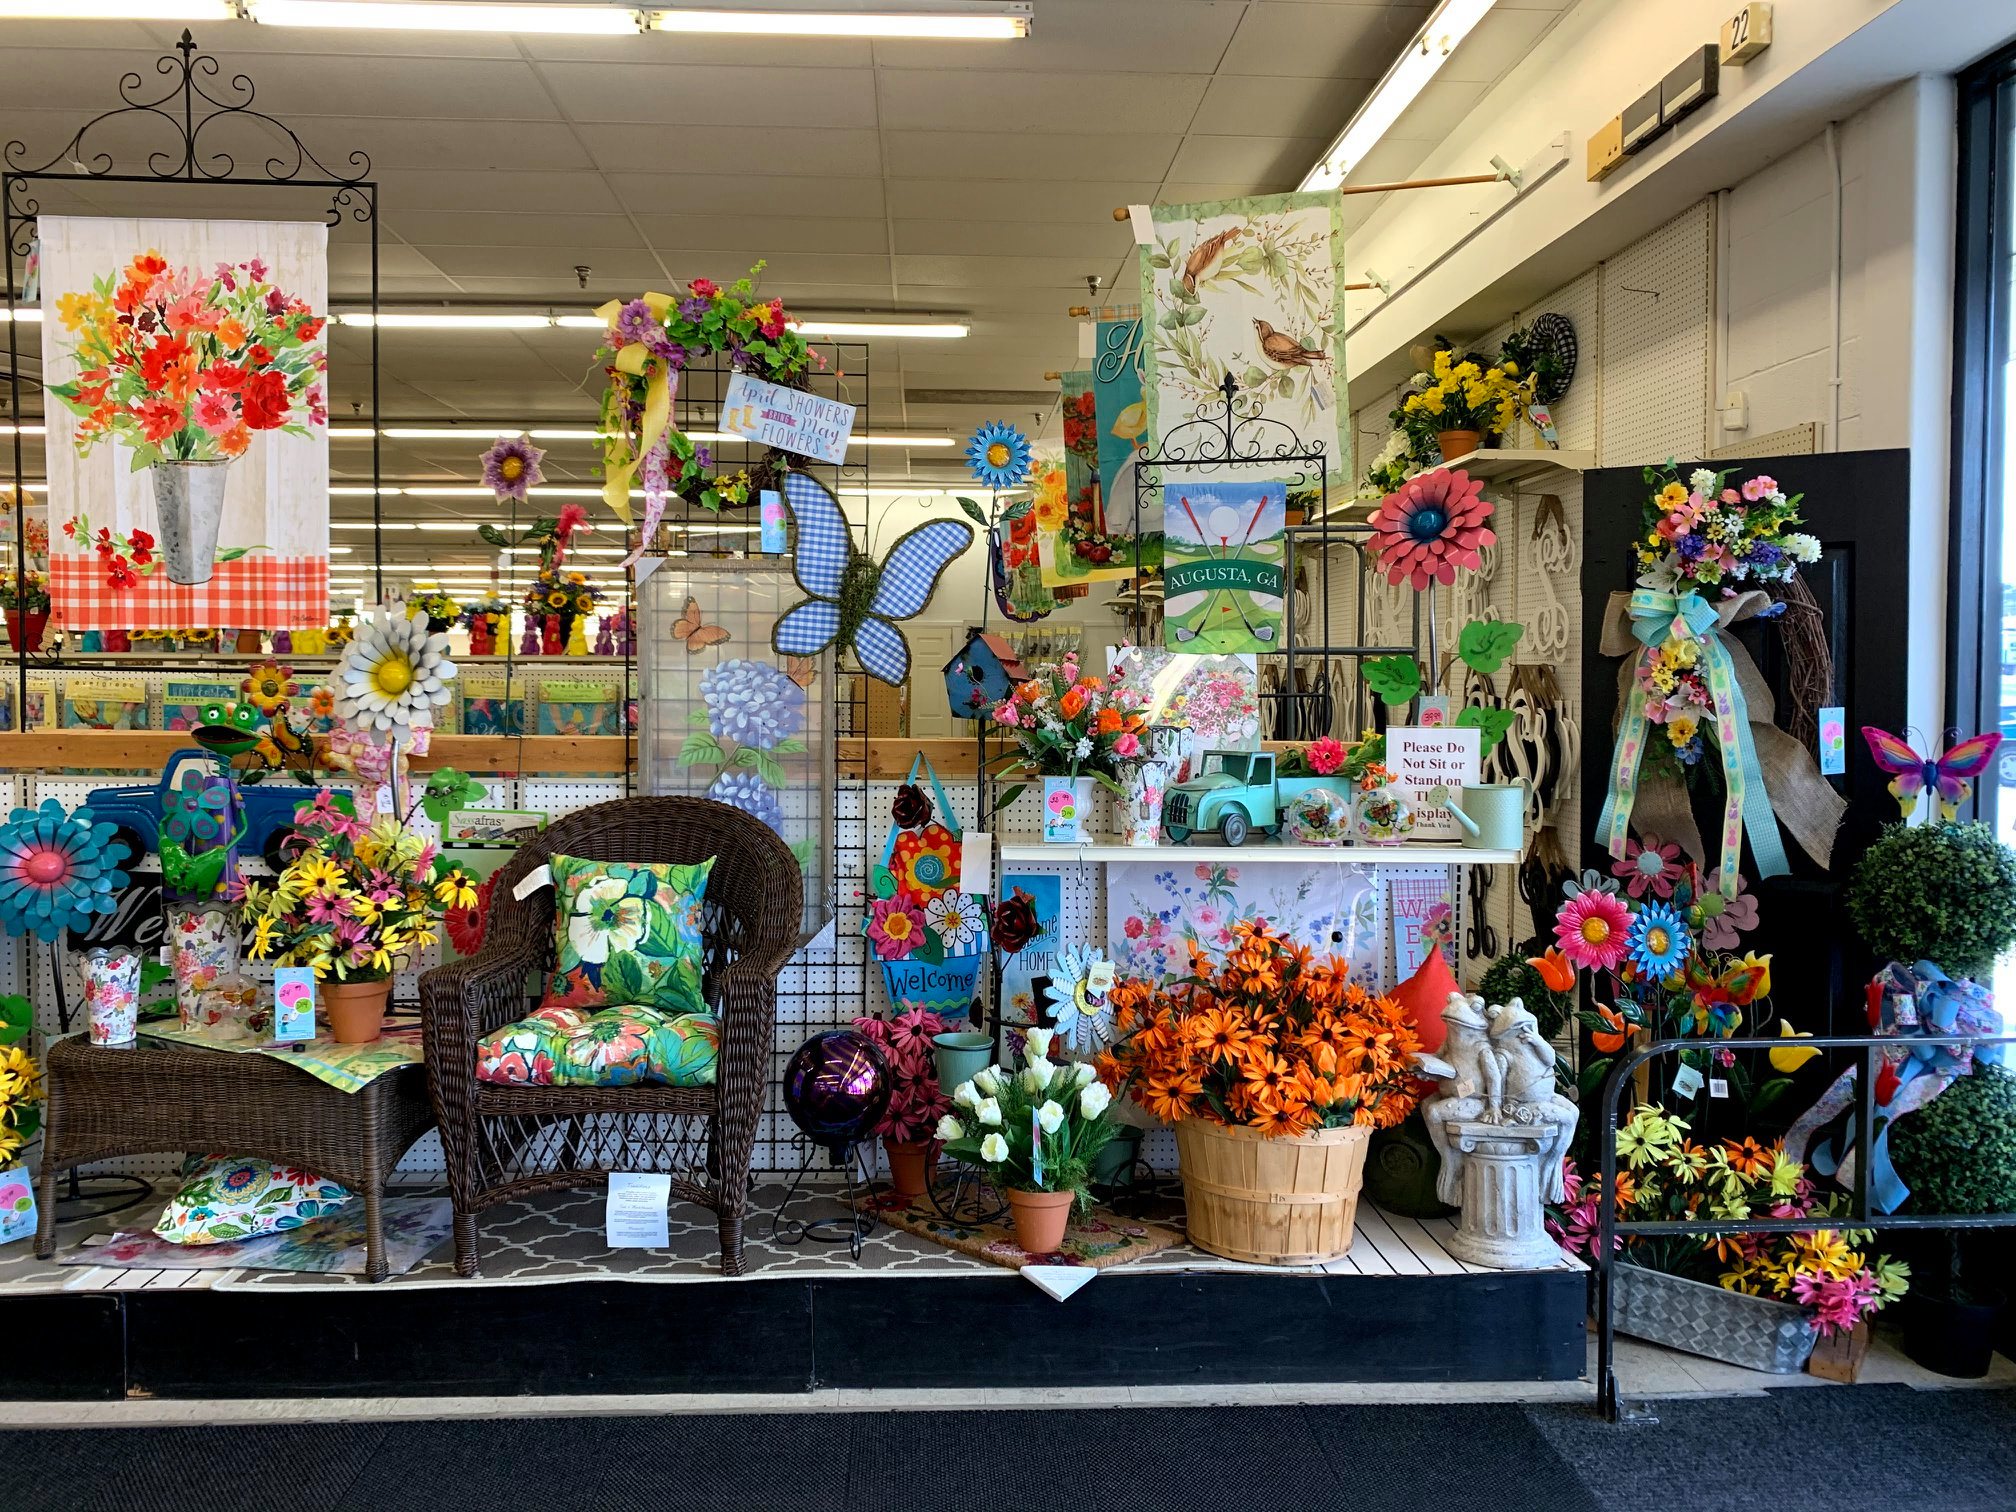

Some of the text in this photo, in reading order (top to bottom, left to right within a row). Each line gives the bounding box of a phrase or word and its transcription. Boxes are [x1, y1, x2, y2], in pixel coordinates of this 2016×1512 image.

[1731, 8, 1750, 51] 22
[735, 381, 850, 427] April SHOWERS
[761, 422, 821, 455] FLOWERS
[768, 409, 840, 446] BRING May
[1170, 567, 1278, 590] AUGUSTA, GA
[1403, 741, 1465, 754] Please Do
[1402, 758, 1465, 770] Not Sit or
[1404, 774, 1462, 786] Stand on
[1417, 807, 1452, 822] isplay
[887, 965, 974, 997] Welcome
